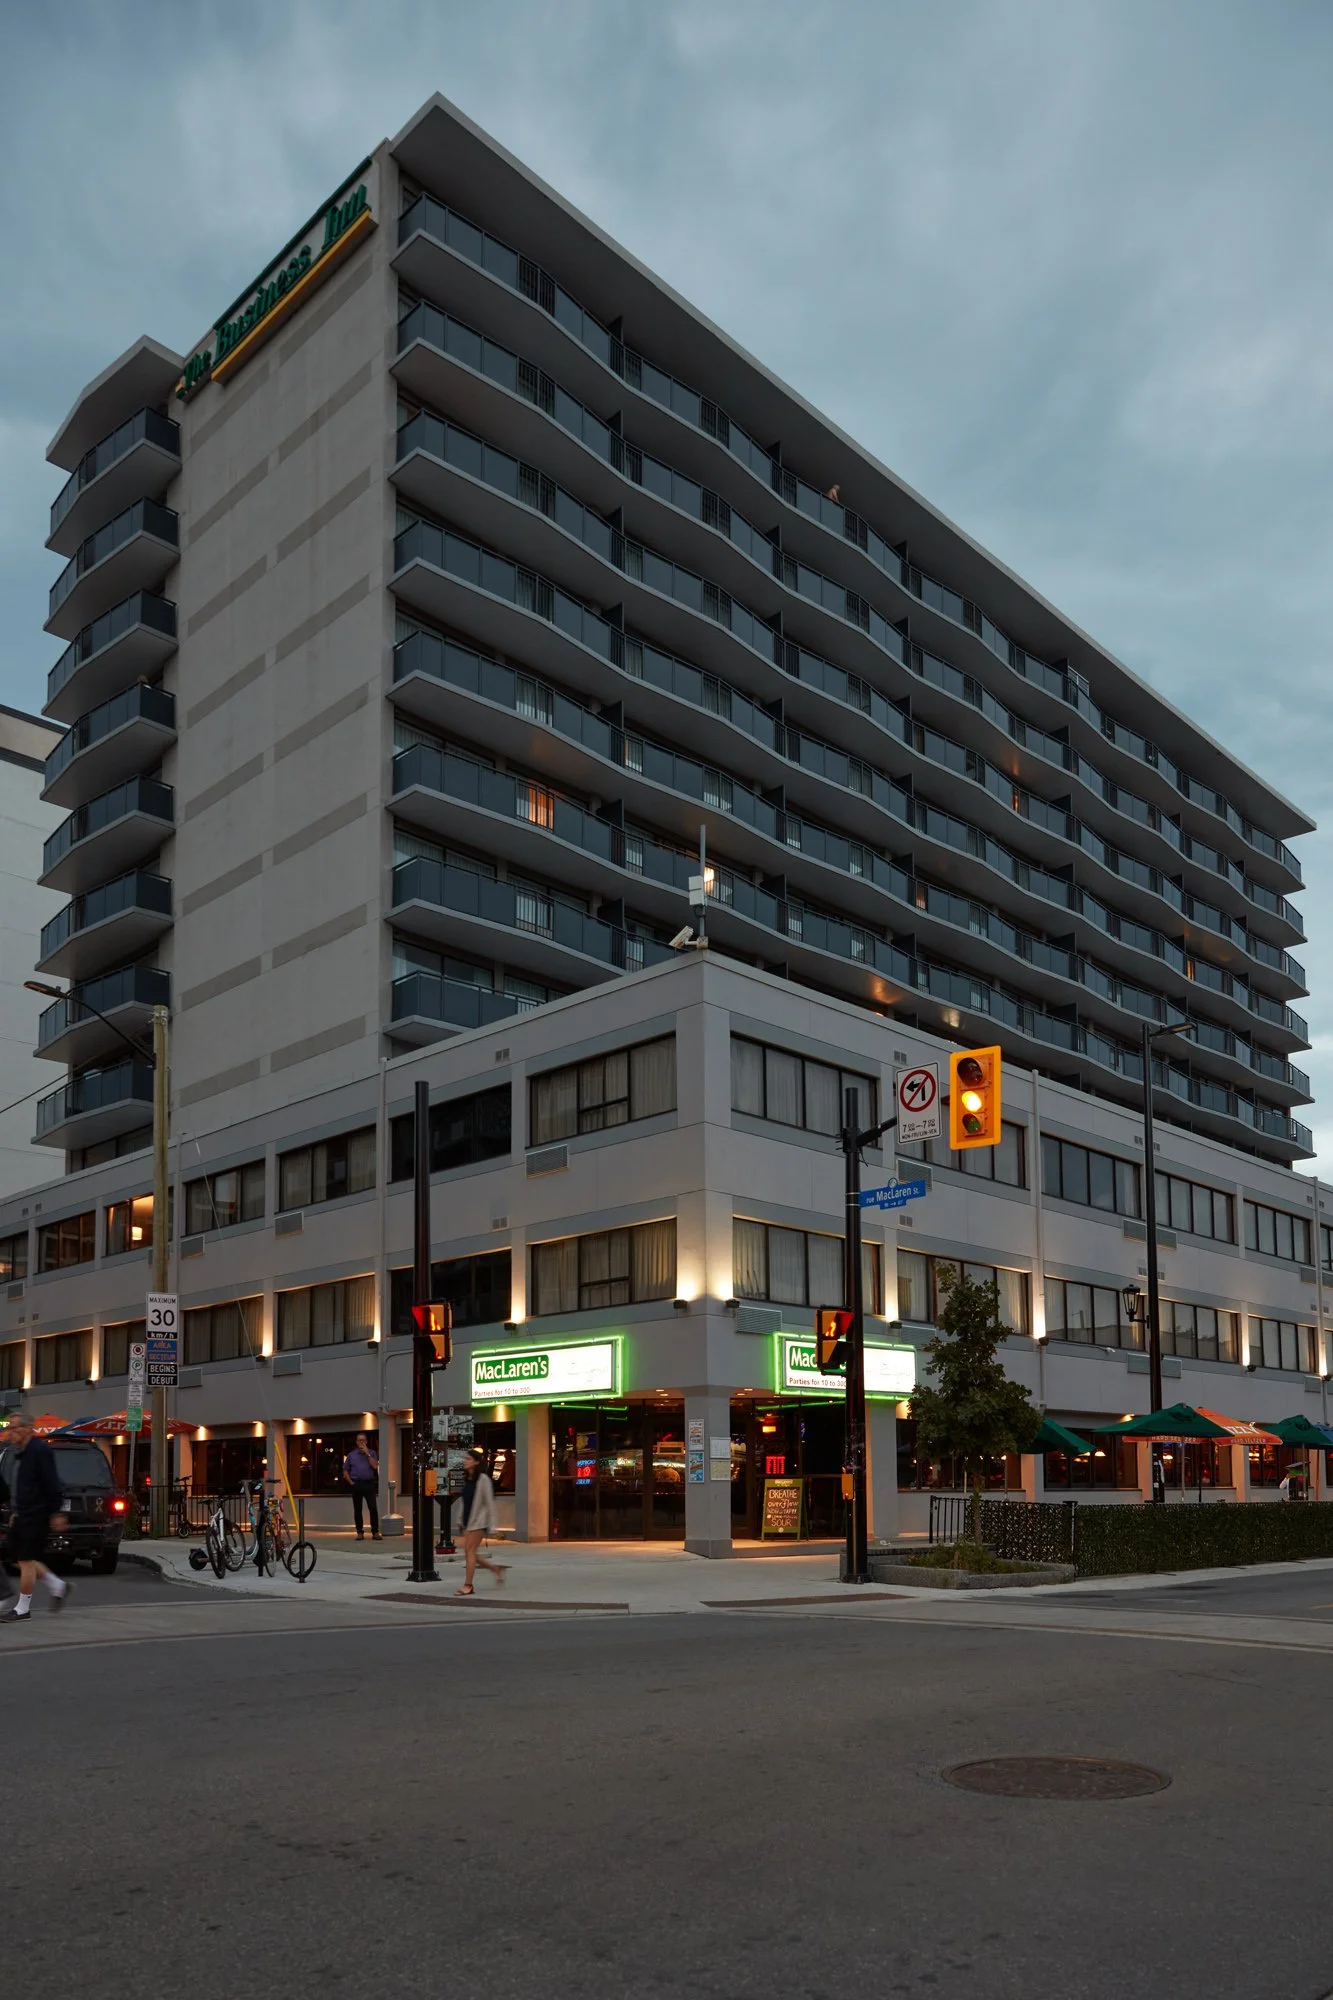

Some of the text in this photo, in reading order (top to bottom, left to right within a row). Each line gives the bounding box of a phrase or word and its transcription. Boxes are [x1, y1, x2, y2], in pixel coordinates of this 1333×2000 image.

[213, 245, 311, 366] Business
[322, 184, 367, 250] Inn
[876, 1187, 912, 1201] MacLaren
[151, 1309, 175, 1327] 30
[150, 1365, 175, 1373] BEGINS
[476, 1357, 547, 1380] MacLaren's
[151, 1375, 174, 1385] DÉBUT
[789, 1377, 810, 1386] Parties
[821, 1379, 828, 1387] 10
[829, 1379, 836, 1387] to
[519, 1386, 531, 1394] 300
[1222, 1425, 1261, 1434] IZZY
[772, 1519, 792, 1527] SOUR
